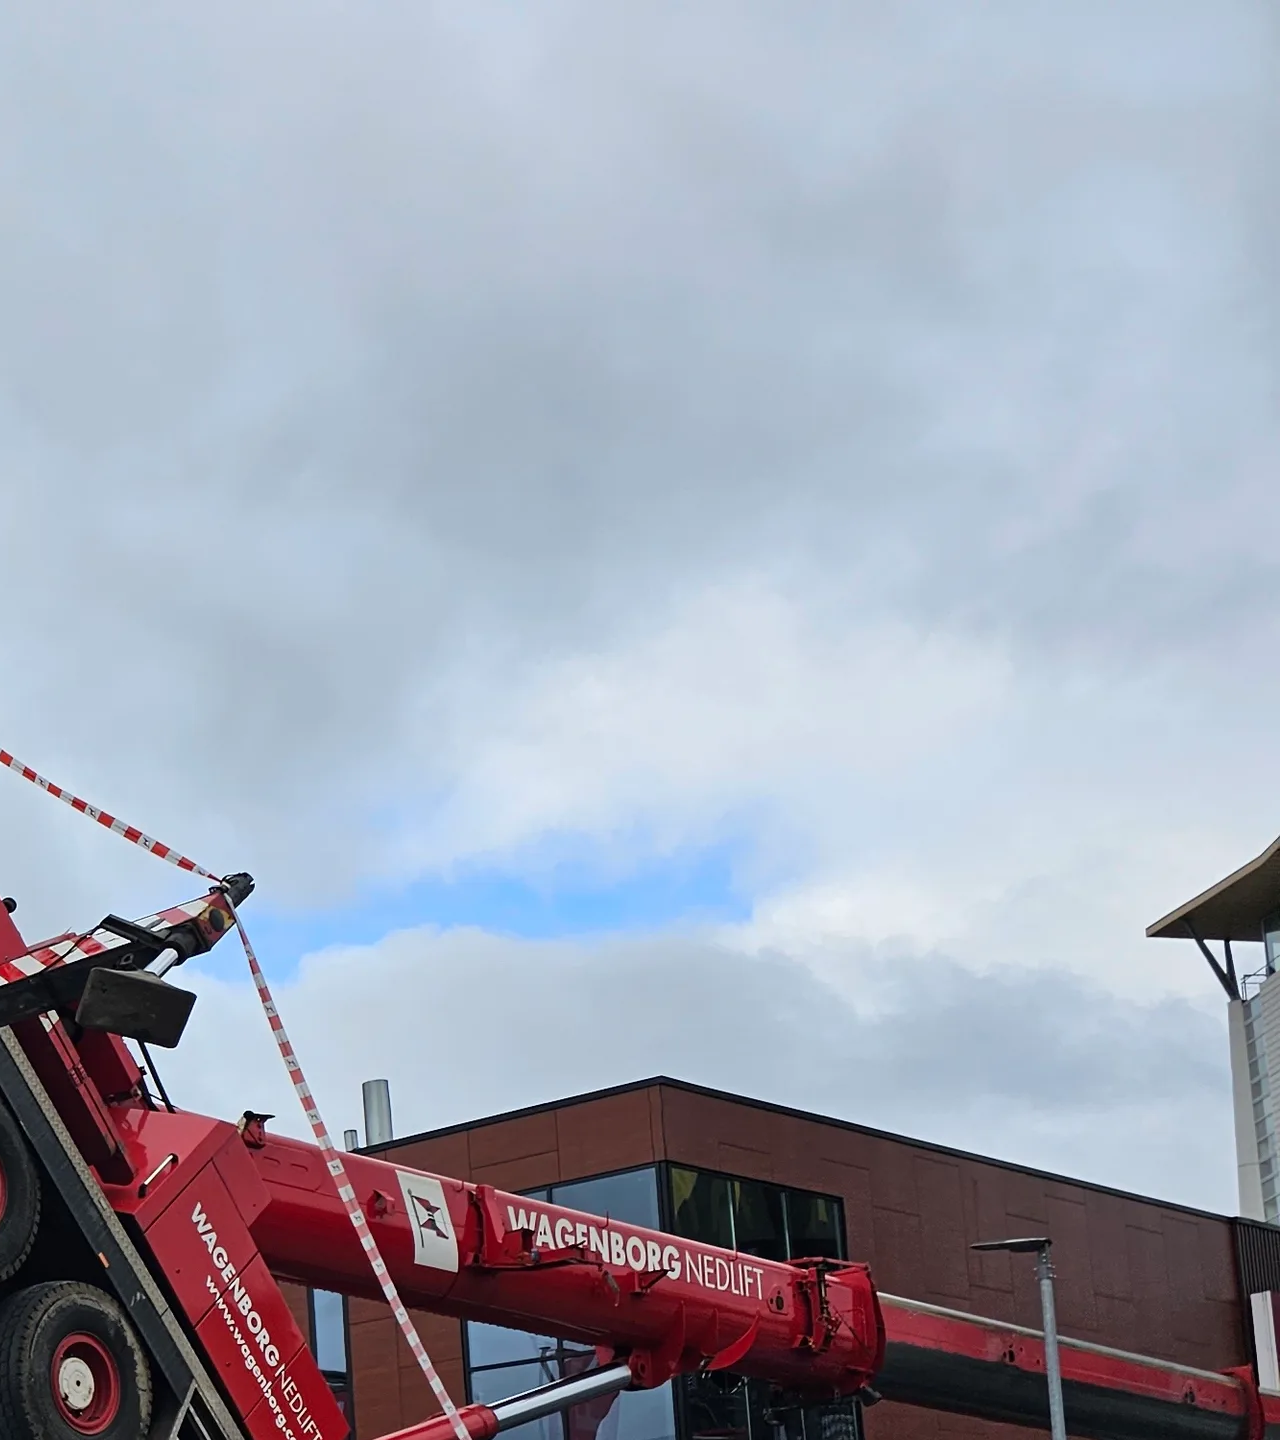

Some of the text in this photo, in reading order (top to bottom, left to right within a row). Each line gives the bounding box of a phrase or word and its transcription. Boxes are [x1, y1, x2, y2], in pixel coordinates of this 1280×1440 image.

[190, 1201, 280, 1368] WAGENBORG
[506, 1205, 765, 1301] WAGENBORG NEDLIFT
